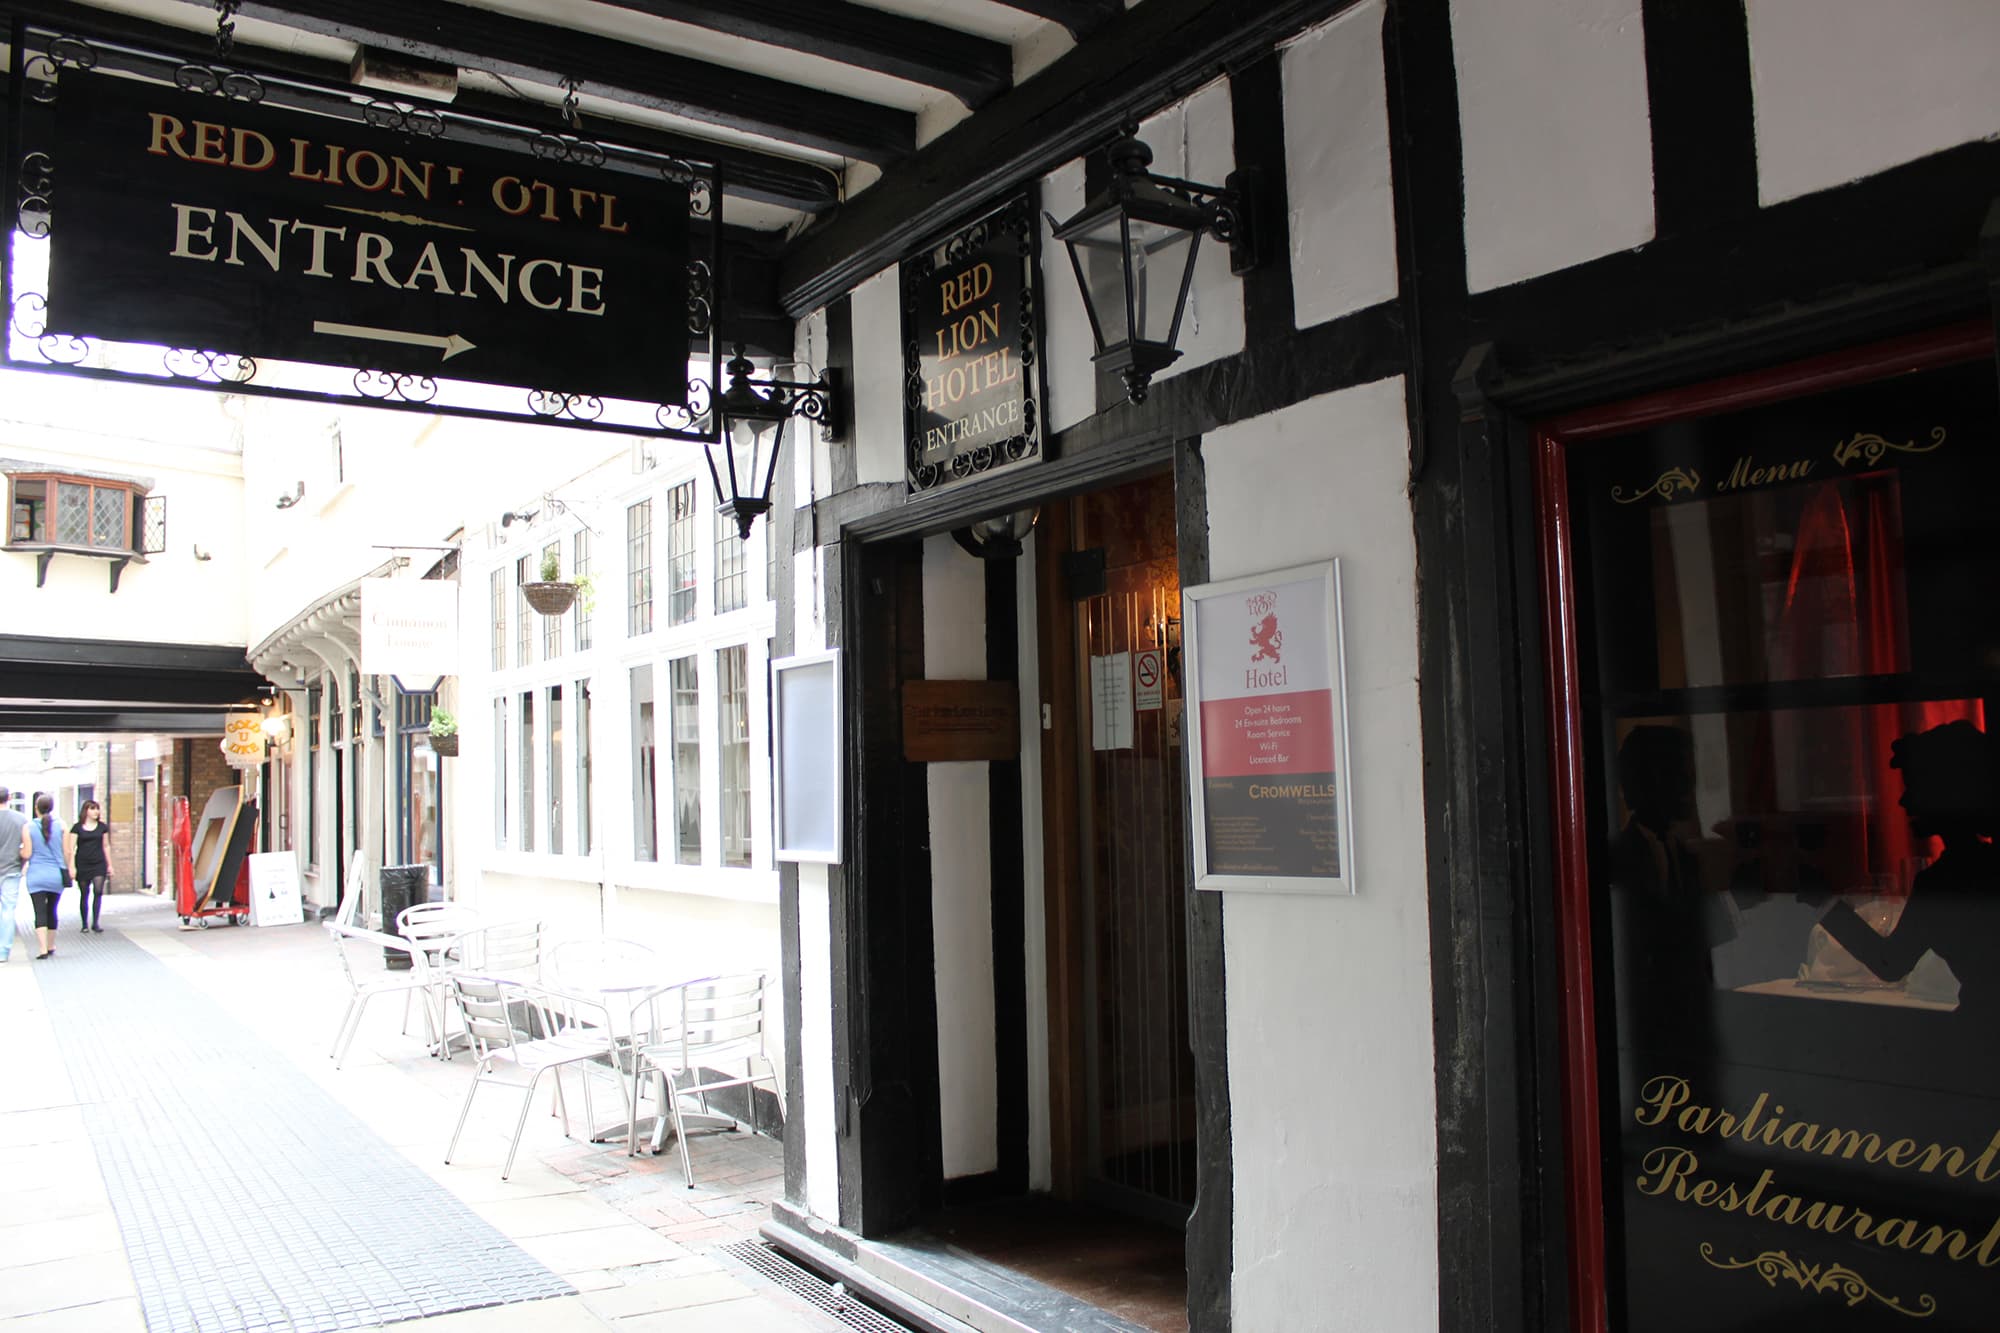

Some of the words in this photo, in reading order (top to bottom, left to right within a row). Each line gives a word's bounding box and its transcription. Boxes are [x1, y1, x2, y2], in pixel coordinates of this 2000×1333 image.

[147, 112, 276, 172] RED
[288, 138, 435, 200] LION
[447, 165, 630, 234] OTL
[169, 203, 606, 316] ENTRANCE
[940, 262, 993, 315] RED
[936, 303, 1001, 363] LION
[926, 347, 1017, 412] HOTEL
[926, 399, 1019, 452] ENTRANCE
[1716, 456, 1816, 492] Menu
[1246, 665, 1288, 689] Hotel
[1244, 706, 1262, 716] Open
[1272, 704, 1291, 713] hours
[1270, 716, 1302, 726] Bedrooms
[239, 731, 248, 742] U
[1247, 730, 1266, 739] Room
[1267, 729, 1291, 738] Service
[1278, 753, 1289, 763] Bar
[1248, 784, 1335, 800] CROMWELLS
[1635, 1075, 2000, 1182] Parliament
[1636, 1146, 2000, 1266] Restaurant
